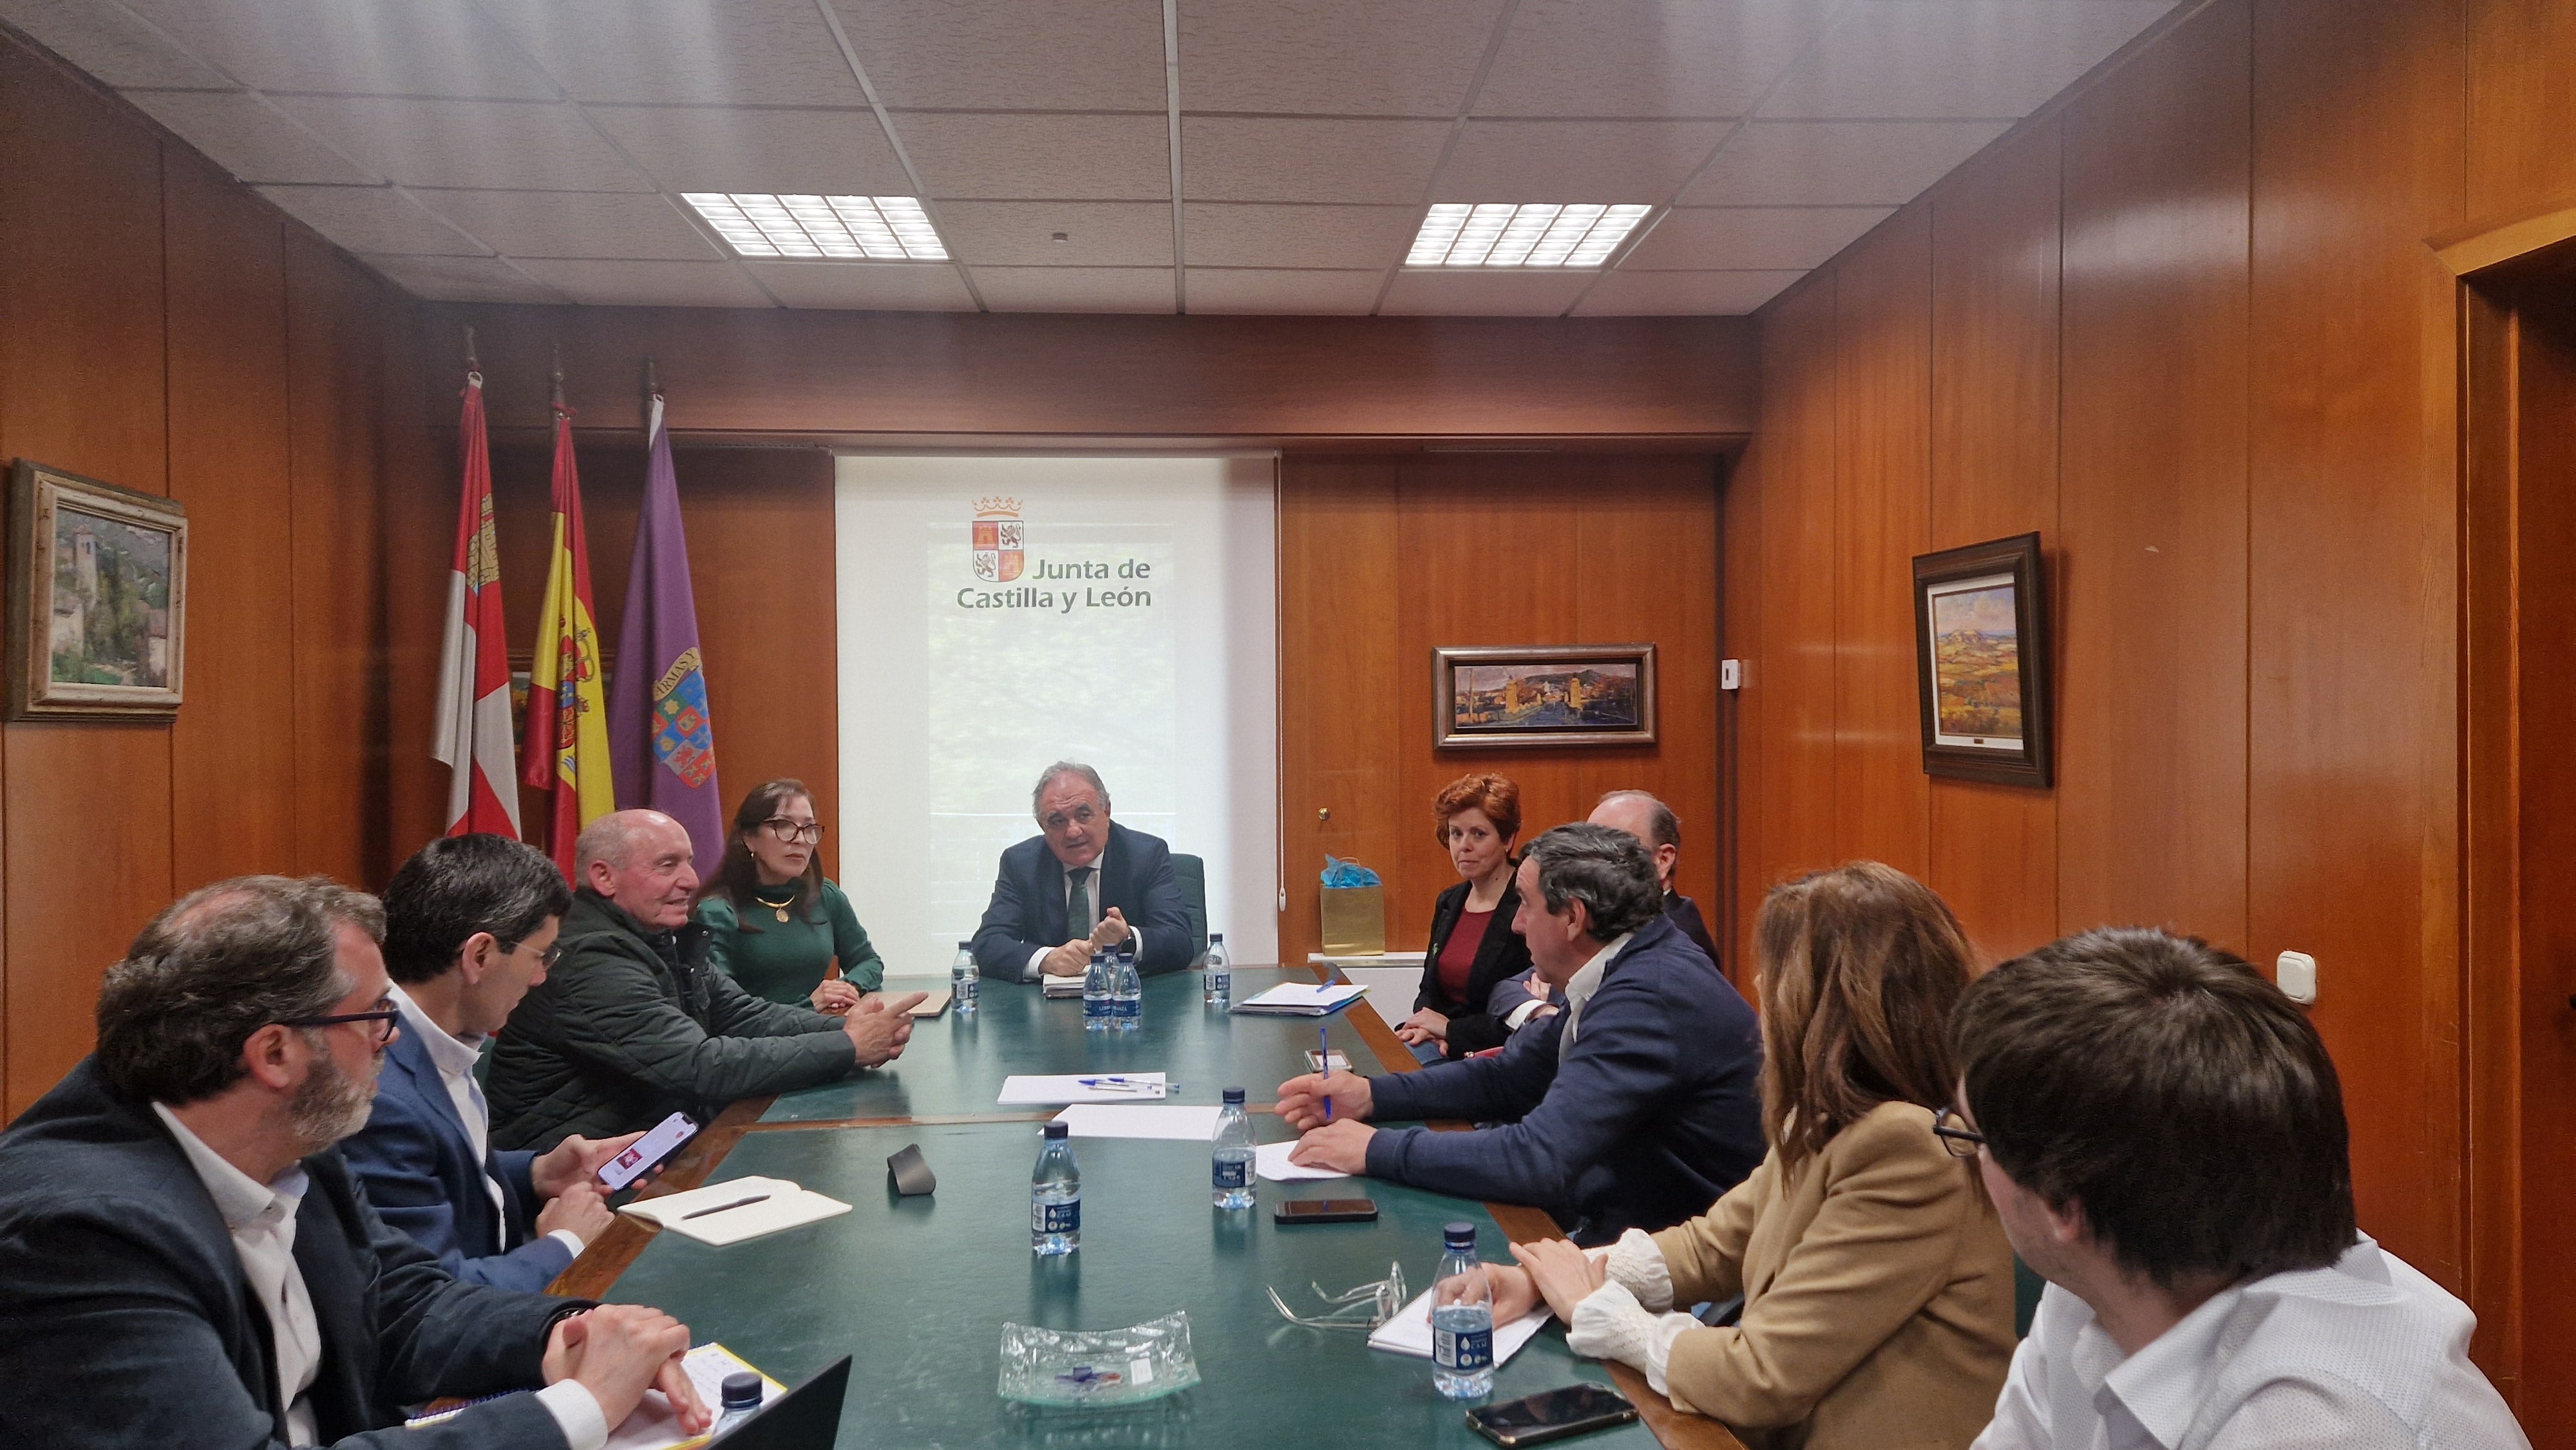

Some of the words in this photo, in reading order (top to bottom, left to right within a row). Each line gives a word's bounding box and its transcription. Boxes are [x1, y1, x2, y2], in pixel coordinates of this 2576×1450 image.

[1032, 558, 1109, 580] Junta
[1118, 558, 1151, 579] de
[956, 587, 1054, 608] Castilla
[1060, 592, 1077, 614] y
[1086, 587, 1151, 607] León
[656, 661, 688, 696] ARMAS
